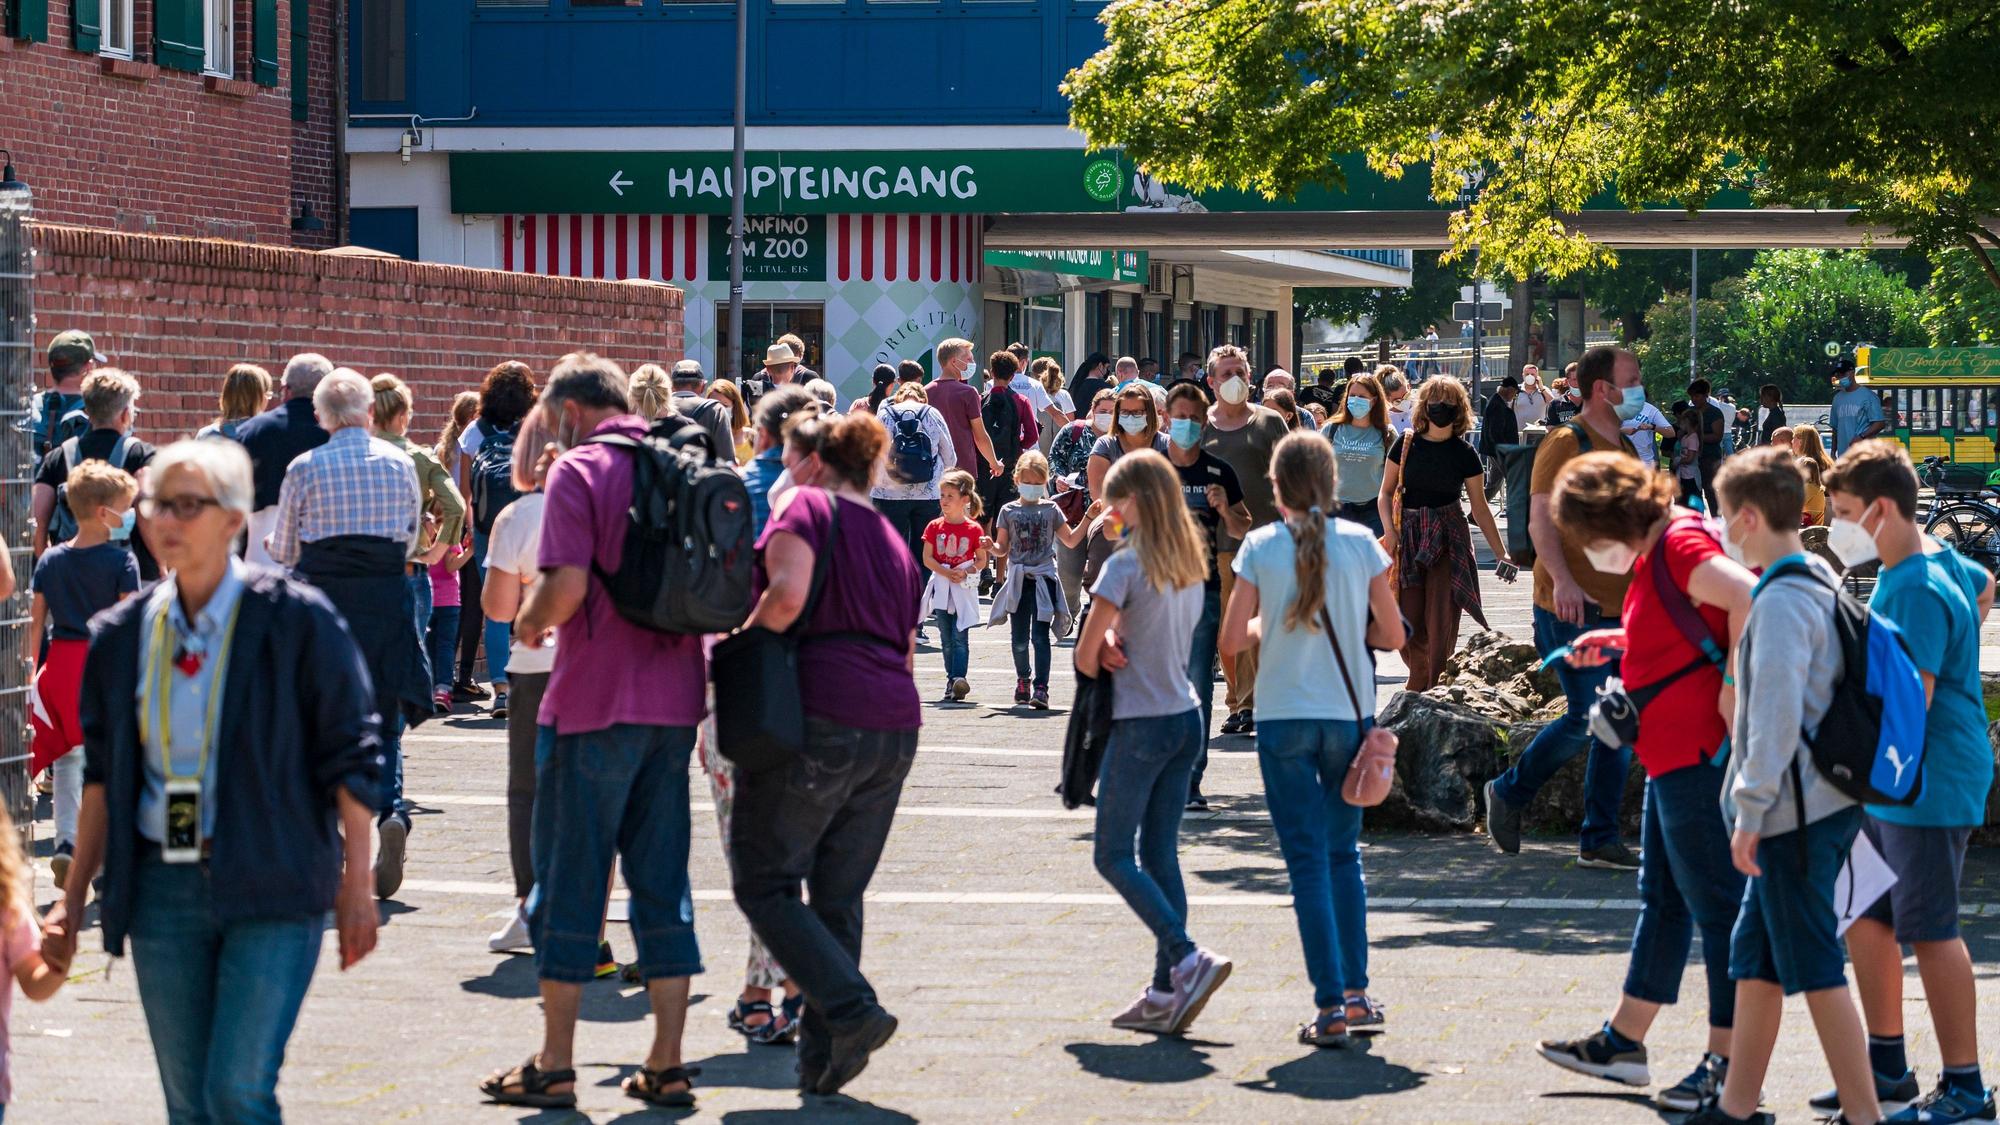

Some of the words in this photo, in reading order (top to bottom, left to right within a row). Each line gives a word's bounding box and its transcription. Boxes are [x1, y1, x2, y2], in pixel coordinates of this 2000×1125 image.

[668, 165, 978, 200] HAUPTEINGANG
[763, 238, 808, 258] ZOO
[791, 265, 809, 273] EIS
